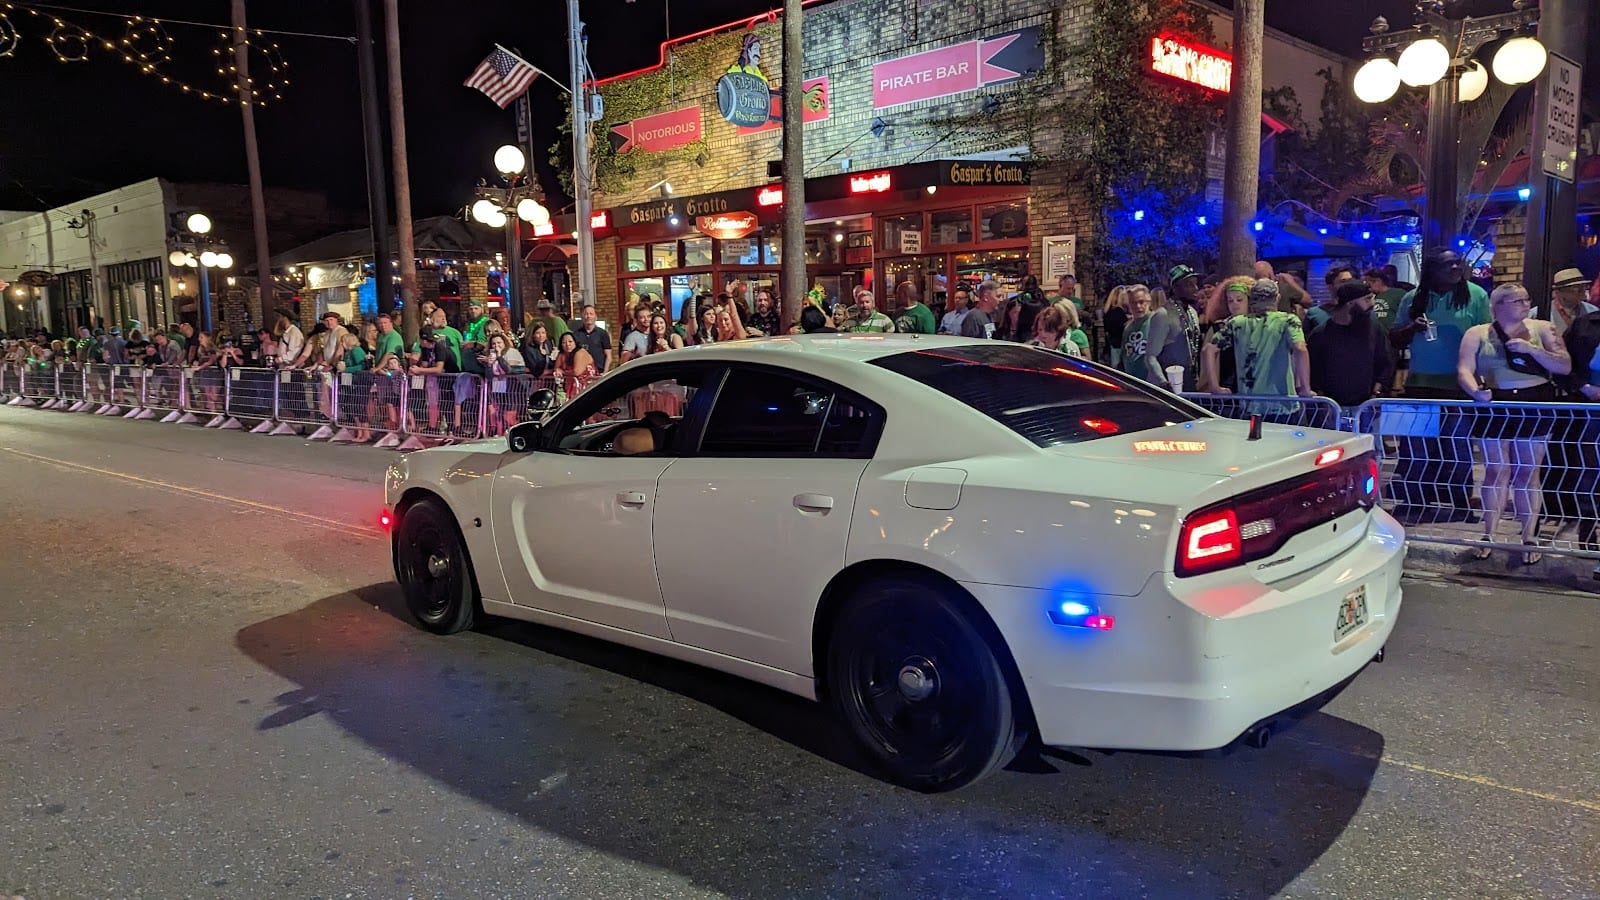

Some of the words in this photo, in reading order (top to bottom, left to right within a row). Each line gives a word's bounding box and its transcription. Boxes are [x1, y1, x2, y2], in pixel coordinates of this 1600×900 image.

[880, 69, 933, 92] PIRATE
[936, 61, 969, 80] BAR
[1559, 66, 1570, 85] NO
[1552, 84, 1575, 106] MOTOR
[1549, 103, 1575, 129] VEHICLE
[637, 121, 696, 143] NOTORIOUS
[1547, 124, 1577, 147] CRUISING
[950, 161, 992, 185] Gaspar's
[994, 162, 1023, 183] Grotto
[630, 201, 674, 224] Gaspar's
[686, 197, 728, 216] Grotto
